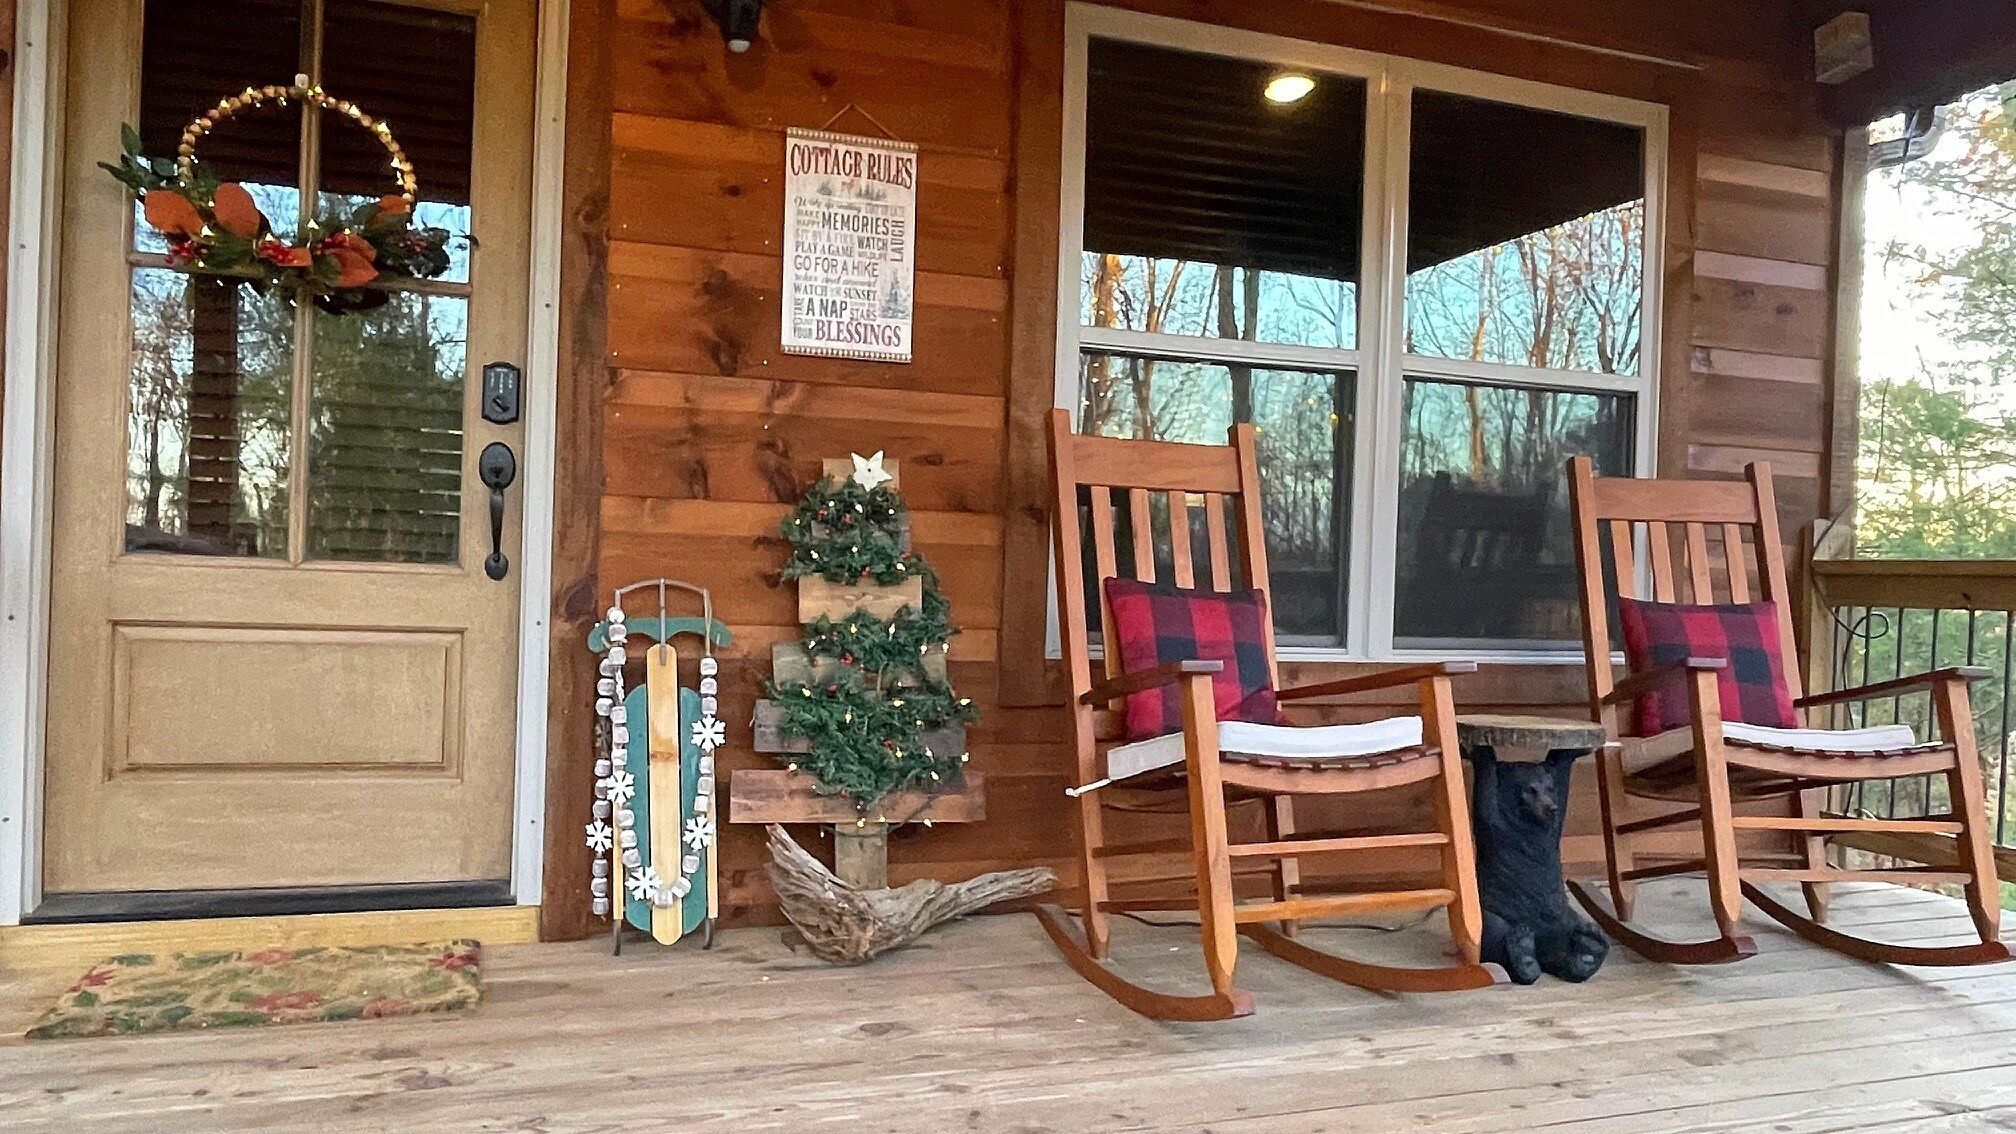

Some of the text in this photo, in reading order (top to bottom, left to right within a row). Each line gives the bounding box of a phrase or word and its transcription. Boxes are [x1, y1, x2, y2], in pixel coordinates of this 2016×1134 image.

[790, 143, 913, 190] COTTAGE RULES
[821, 210, 890, 236] MEMORIES
[794, 241, 854, 258] PLAY A GAME
[857, 235, 888, 252] WATCH
[890, 219, 905, 263] LAUGH
[793, 254, 879, 278] GO FOR A HIKE
[793, 282, 828, 297] WATCH
[843, 287, 877, 302] SUNSET
[805, 297, 815, 317] A
[819, 298, 848, 319] NAP
[815, 319, 902, 347] BLESSINGS
